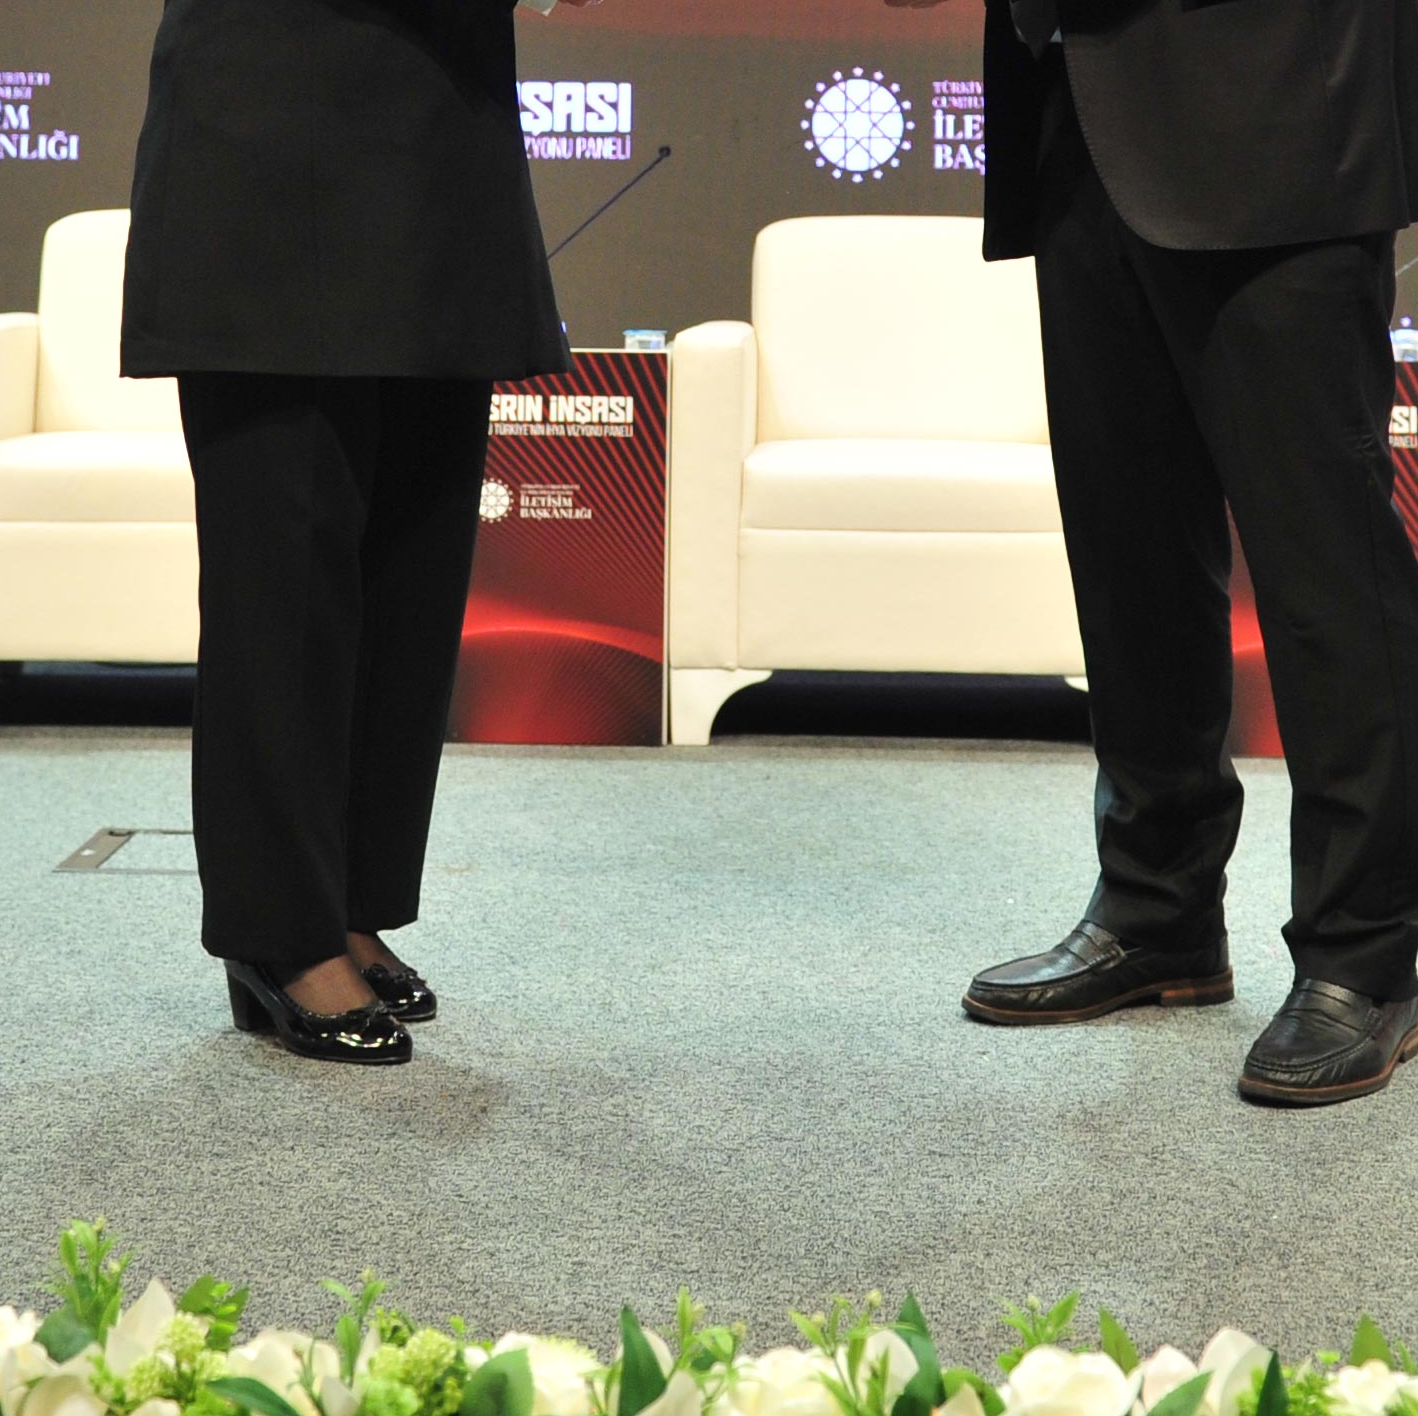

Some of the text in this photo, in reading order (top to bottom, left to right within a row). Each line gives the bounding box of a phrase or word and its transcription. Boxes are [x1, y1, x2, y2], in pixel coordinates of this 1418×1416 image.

[518, 81, 632, 136] ŞASI
[525, 136, 574, 160] YONU
[490, 394, 543, 422] SRIN
